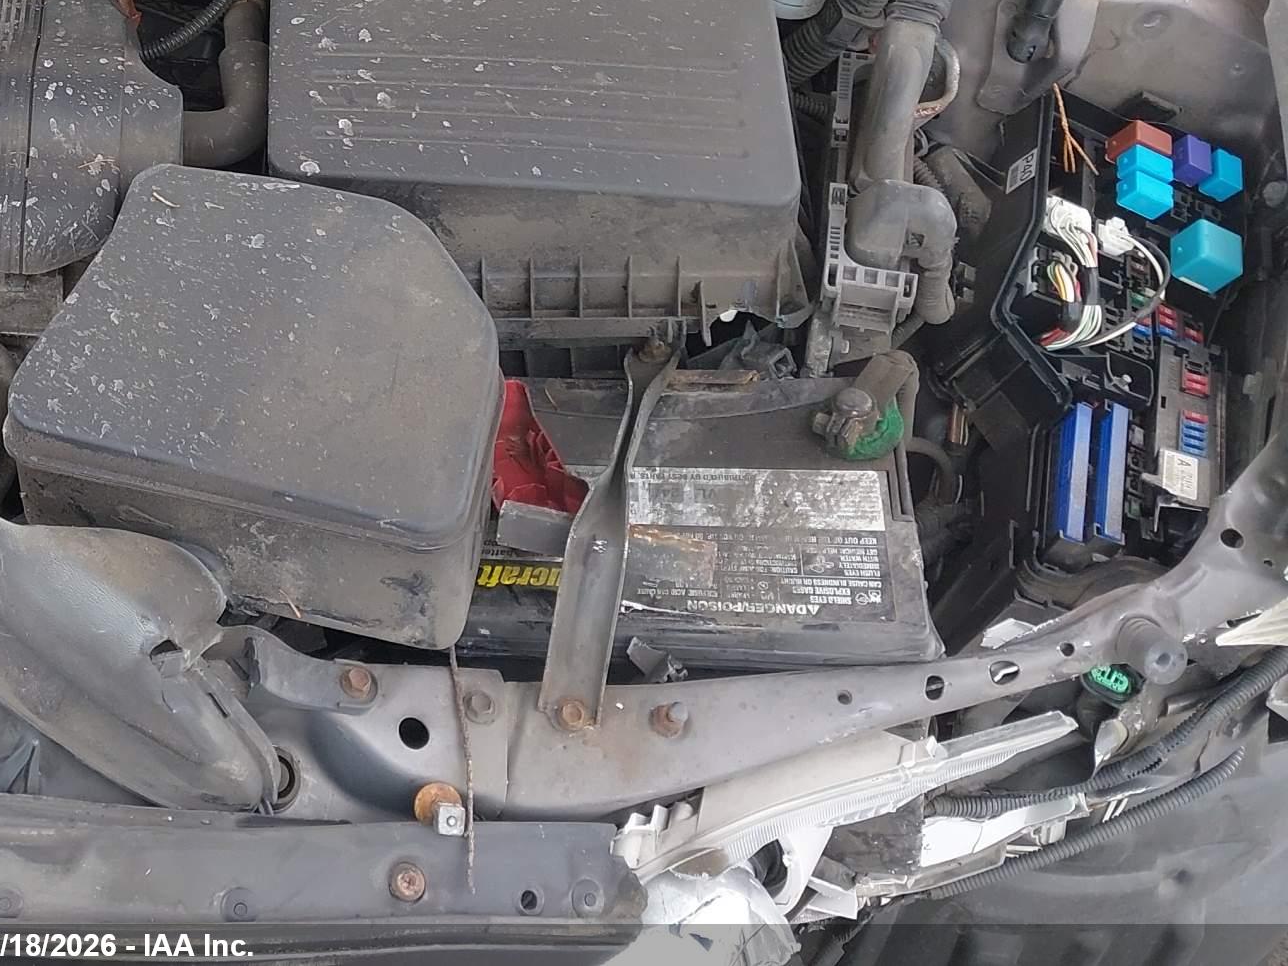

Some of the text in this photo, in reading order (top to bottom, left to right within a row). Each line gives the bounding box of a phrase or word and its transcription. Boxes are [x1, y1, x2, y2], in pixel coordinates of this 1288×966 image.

[860, 537, 877, 545] KEEP
[477, 565, 562, 587] ucraft
[810, 594, 827, 604] EYES
[686, 599, 807, 615] DANGER/POISON
